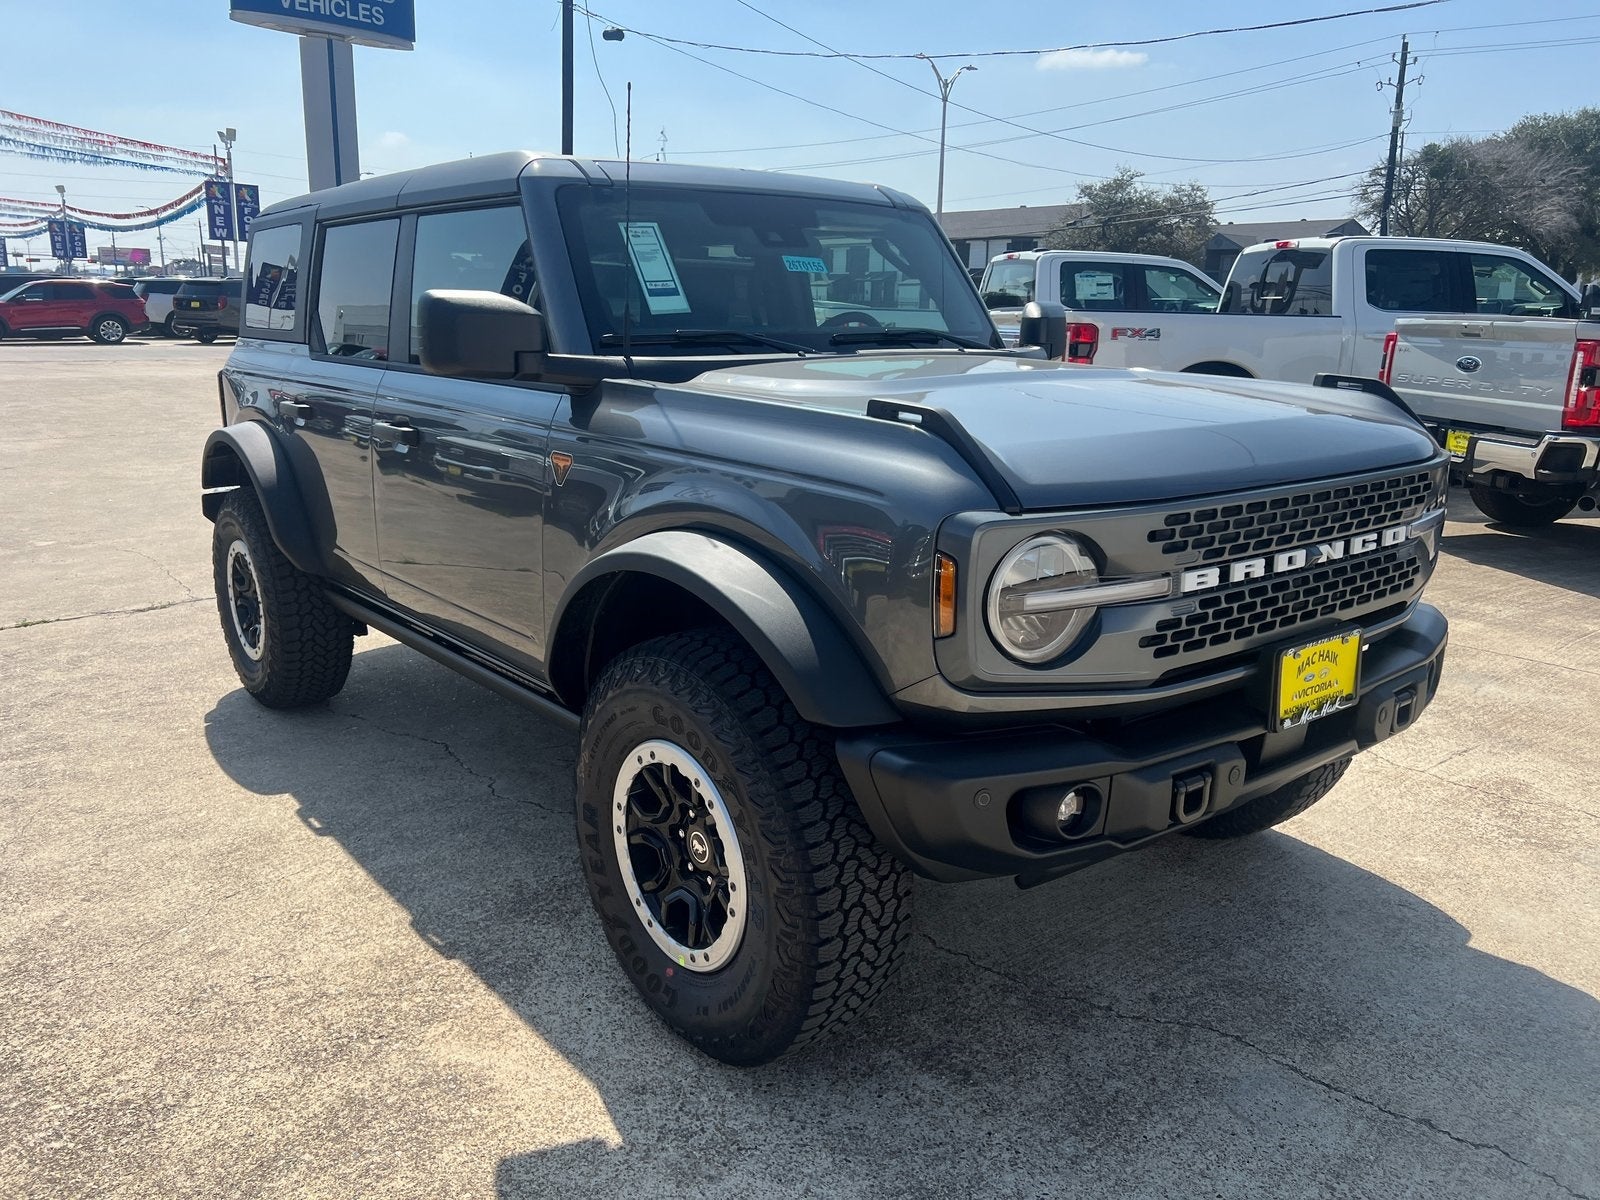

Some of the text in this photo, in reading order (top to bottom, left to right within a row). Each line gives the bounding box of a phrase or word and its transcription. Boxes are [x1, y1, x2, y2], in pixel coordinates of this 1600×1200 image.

[280, 0, 385, 25] VEHICLES
[213, 204, 228, 238] NEW
[54, 235, 65, 256] NEW
[74, 236, 83, 257] FORD
[784, 259, 825, 272] 26T0155
[1111, 327, 1161, 340] FX4
[1398, 373, 1554, 397] SUPER DUTY
[1181, 526, 1407, 592] BRONCO
[1296, 649, 1339, 679] MAC HAIK
[1296, 680, 1332, 699] VICTORIA
[1300, 706, 1320, 725] Mac
